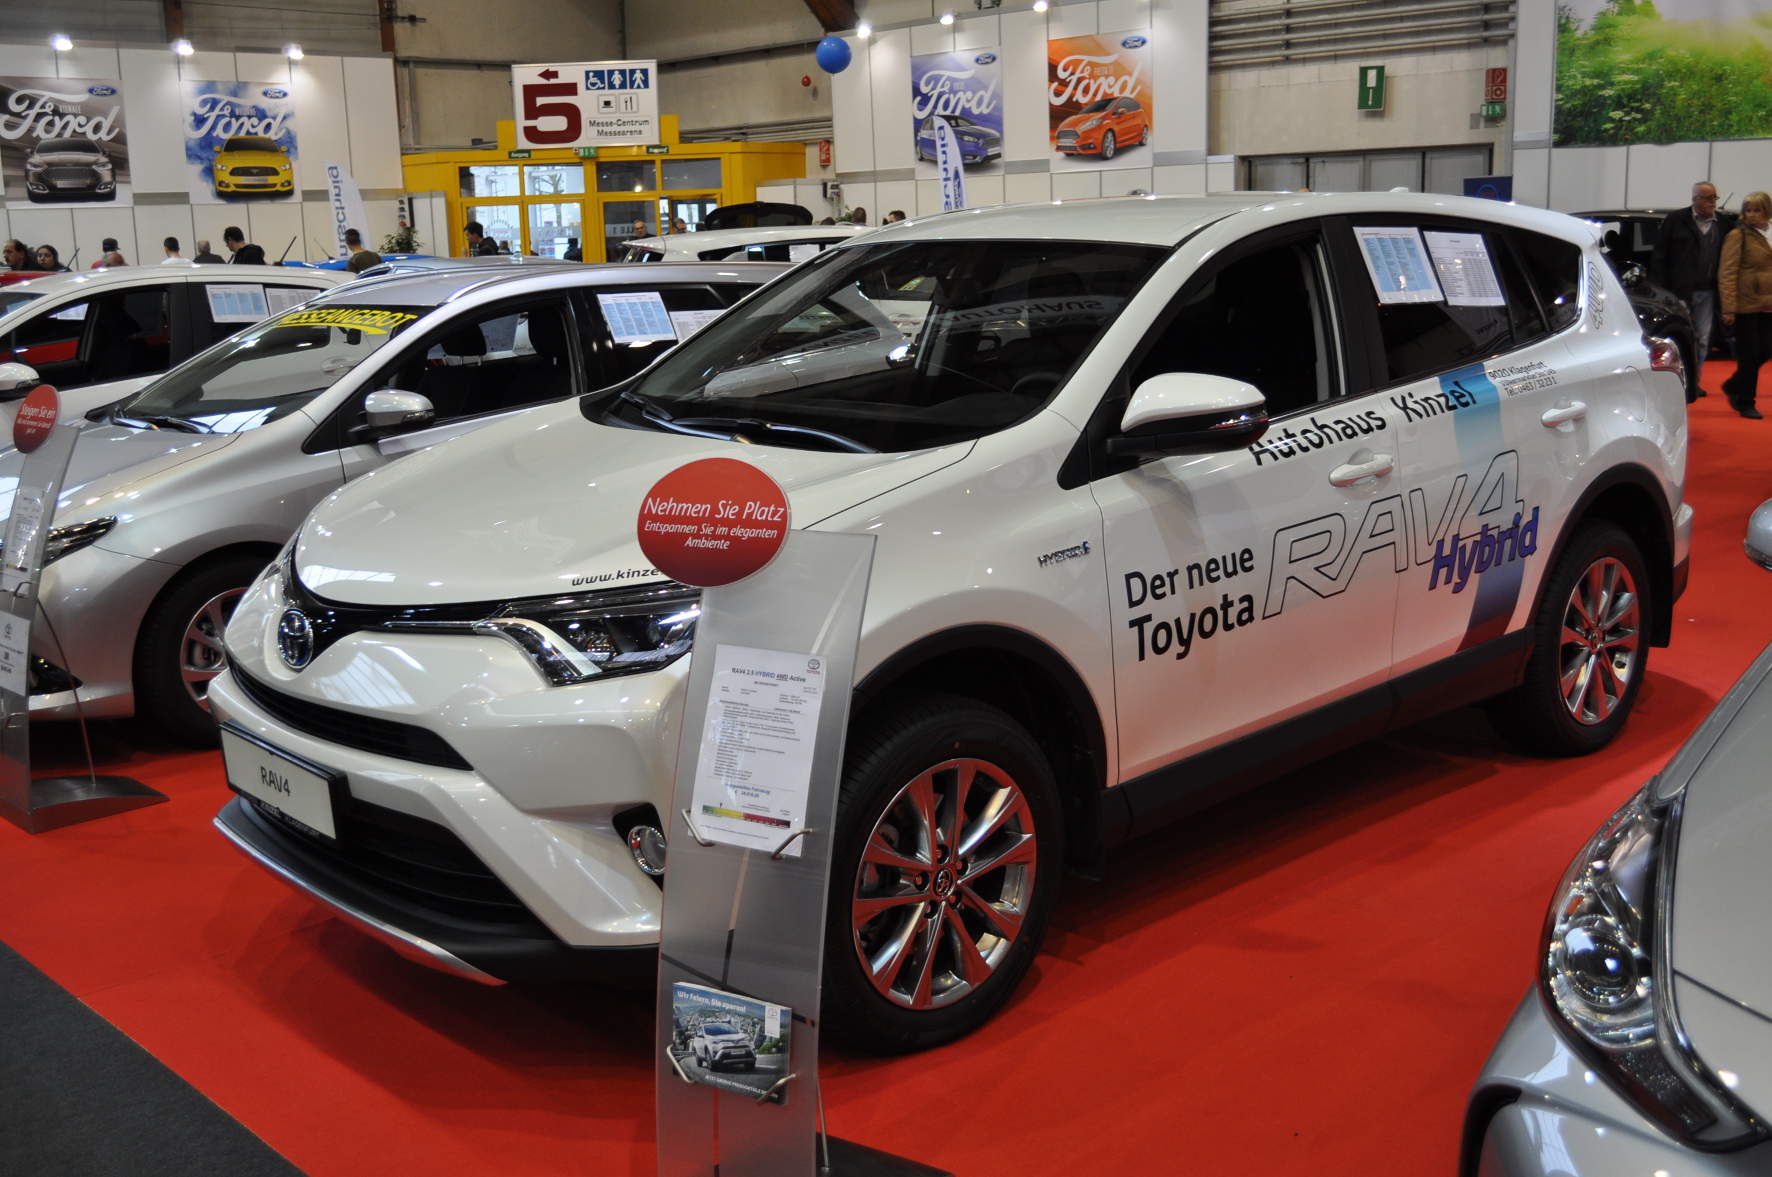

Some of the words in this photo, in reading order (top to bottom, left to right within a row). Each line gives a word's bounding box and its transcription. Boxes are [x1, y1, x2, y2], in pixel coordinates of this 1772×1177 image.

[913, 70, 998, 119] Ford
[1048, 53, 1144, 106] Ford
[0, 89, 121, 140] Ford
[184, 94, 287, 140] Ford
[523, 82, 582, 144] 5
[589, 119, 650, 128] Messe-Centrum
[1248, 409, 1387, 466] Autohaus
[1391, 381, 1477, 423] Kinzel
[644, 497, 711, 517] Nehmen
[715, 500, 739, 519] Sie
[742, 501, 785, 521] Platz
[645, 520, 698, 535] Entspannen
[701, 523, 714, 535] Sie
[716, 526, 729, 535] im
[730, 527, 777, 541] eleganten
[684, 536, 731, 550] Ambiente
[1262, 449, 1525, 620] RAV4
[1428, 506, 1539, 594] Hybrid
[571, 567, 665, 587] www.kinze
[1124, 569, 1179, 609] Der
[1186, 547, 1255, 591] neue
[1128, 592, 1255, 662] Toyota
[260, 766, 291, 797] RAV4
